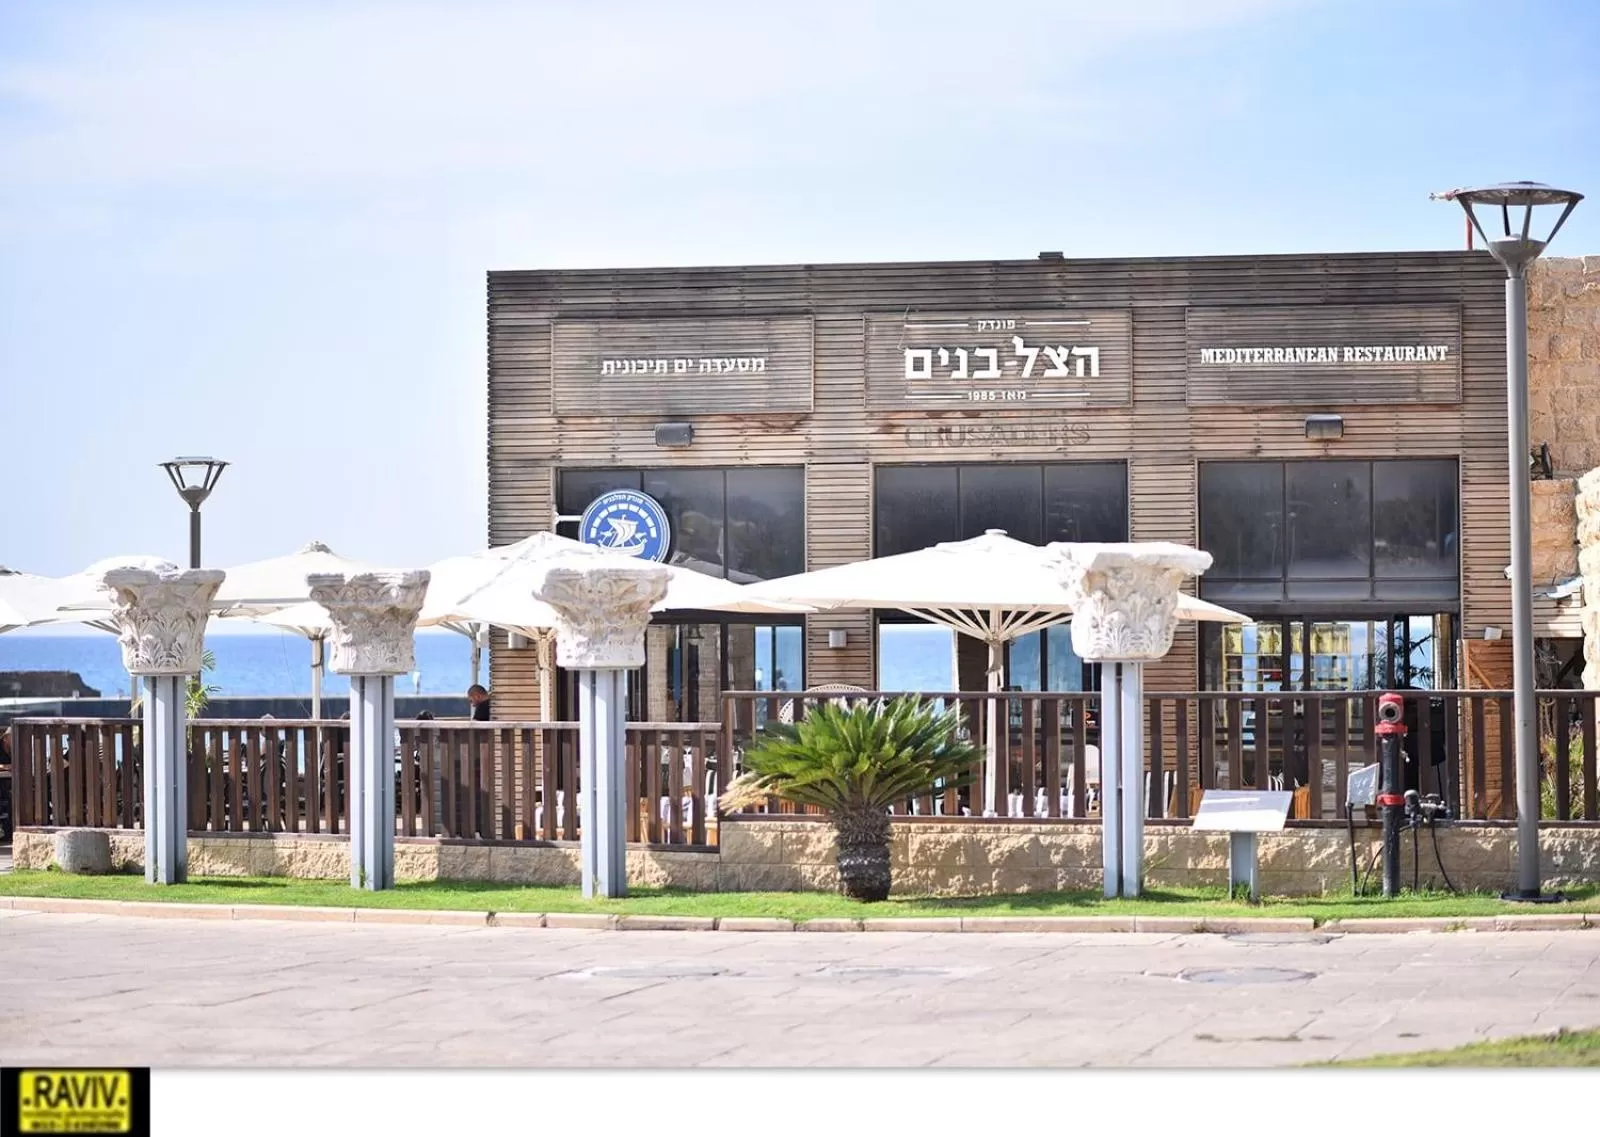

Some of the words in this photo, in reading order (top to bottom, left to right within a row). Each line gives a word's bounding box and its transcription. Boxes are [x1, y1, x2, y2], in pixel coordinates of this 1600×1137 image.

[977, 320, 1016, 333] פונדק
[1200, 347, 1338, 364] MEDITERRANEAN
[1342, 345, 1449, 362] RESTAURANT
[601, 359, 668, 375] תיכונית
[673, 359, 693, 373] ים
[967, 390, 996, 401] 1985
[1002, 390, 1027, 400] מאז
